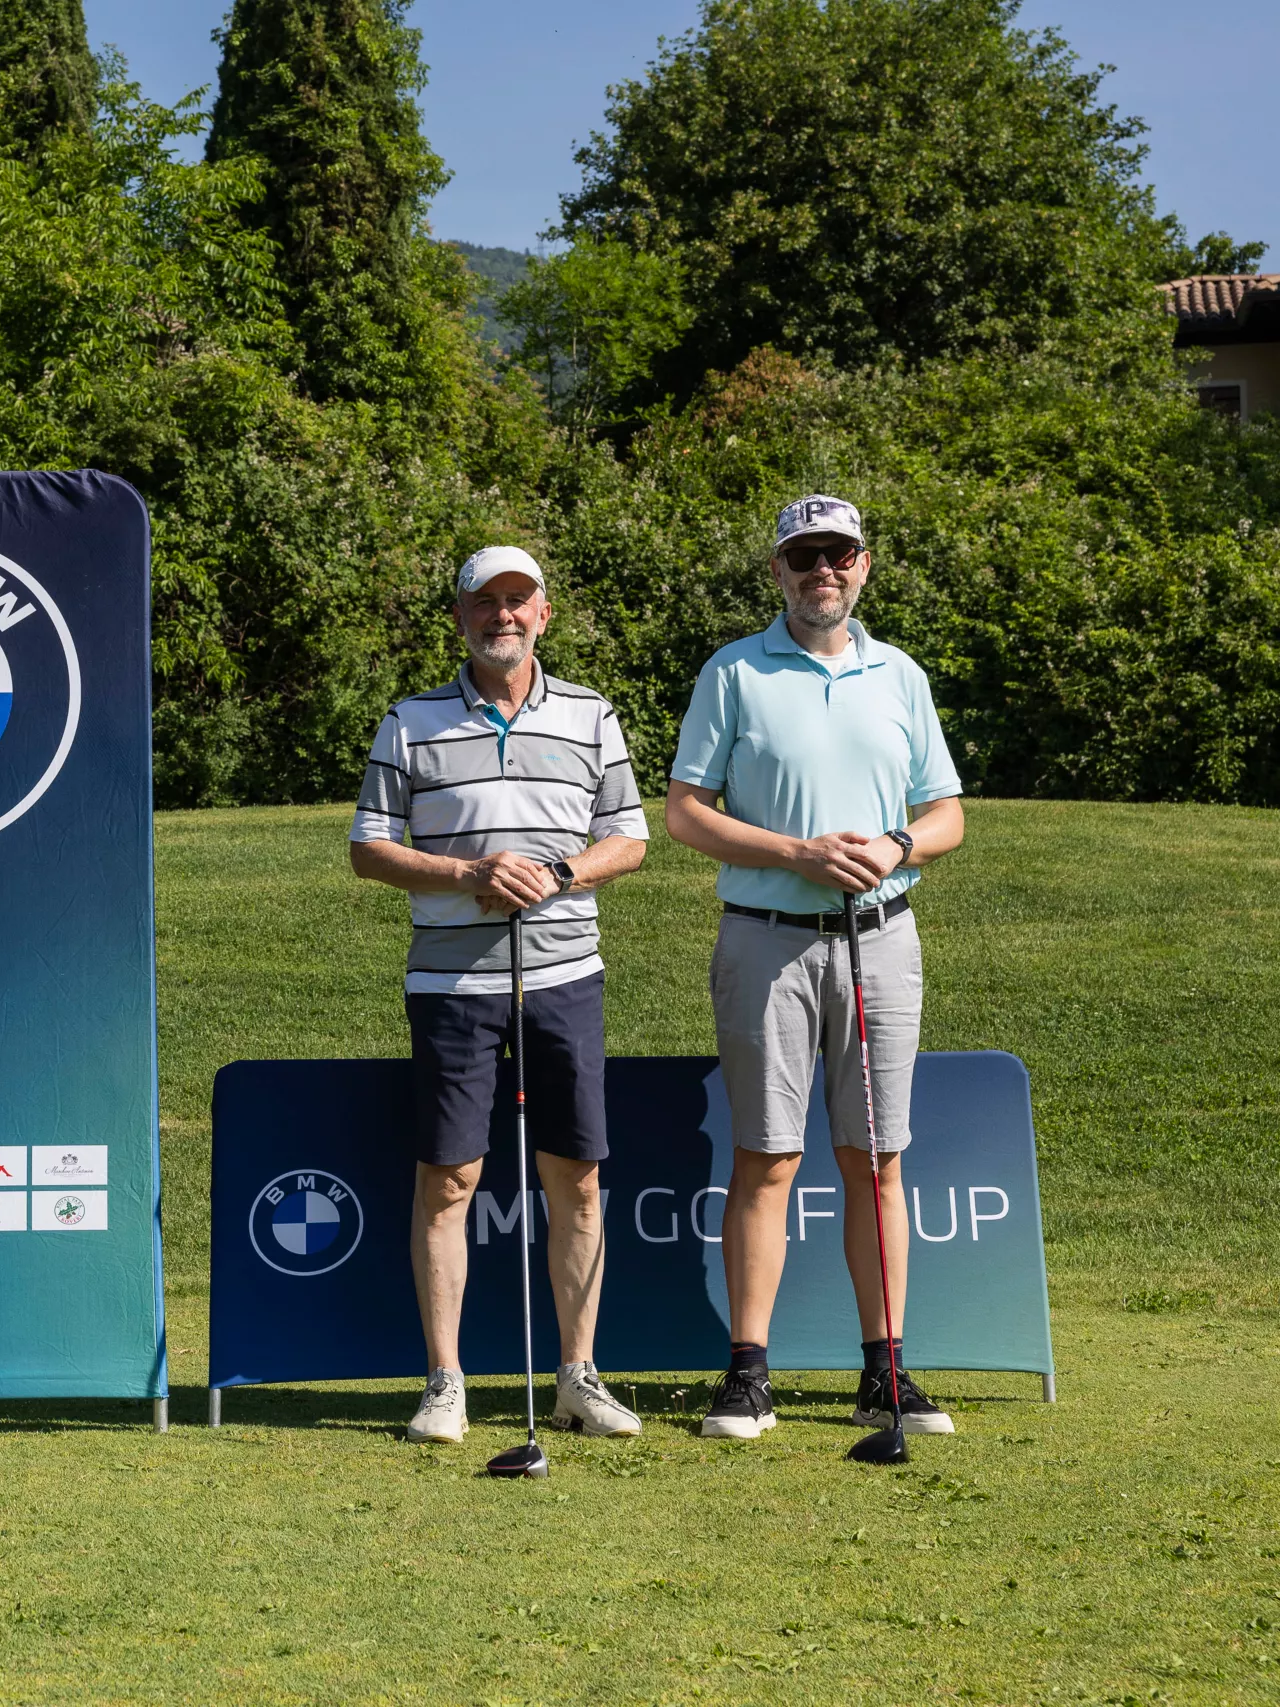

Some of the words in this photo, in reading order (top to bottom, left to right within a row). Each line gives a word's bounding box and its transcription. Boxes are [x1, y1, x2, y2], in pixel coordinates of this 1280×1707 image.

[265, 1175, 348, 1206] BMW
[635, 1186, 836, 1243] GOF
[913, 1186, 1010, 1242] UP
